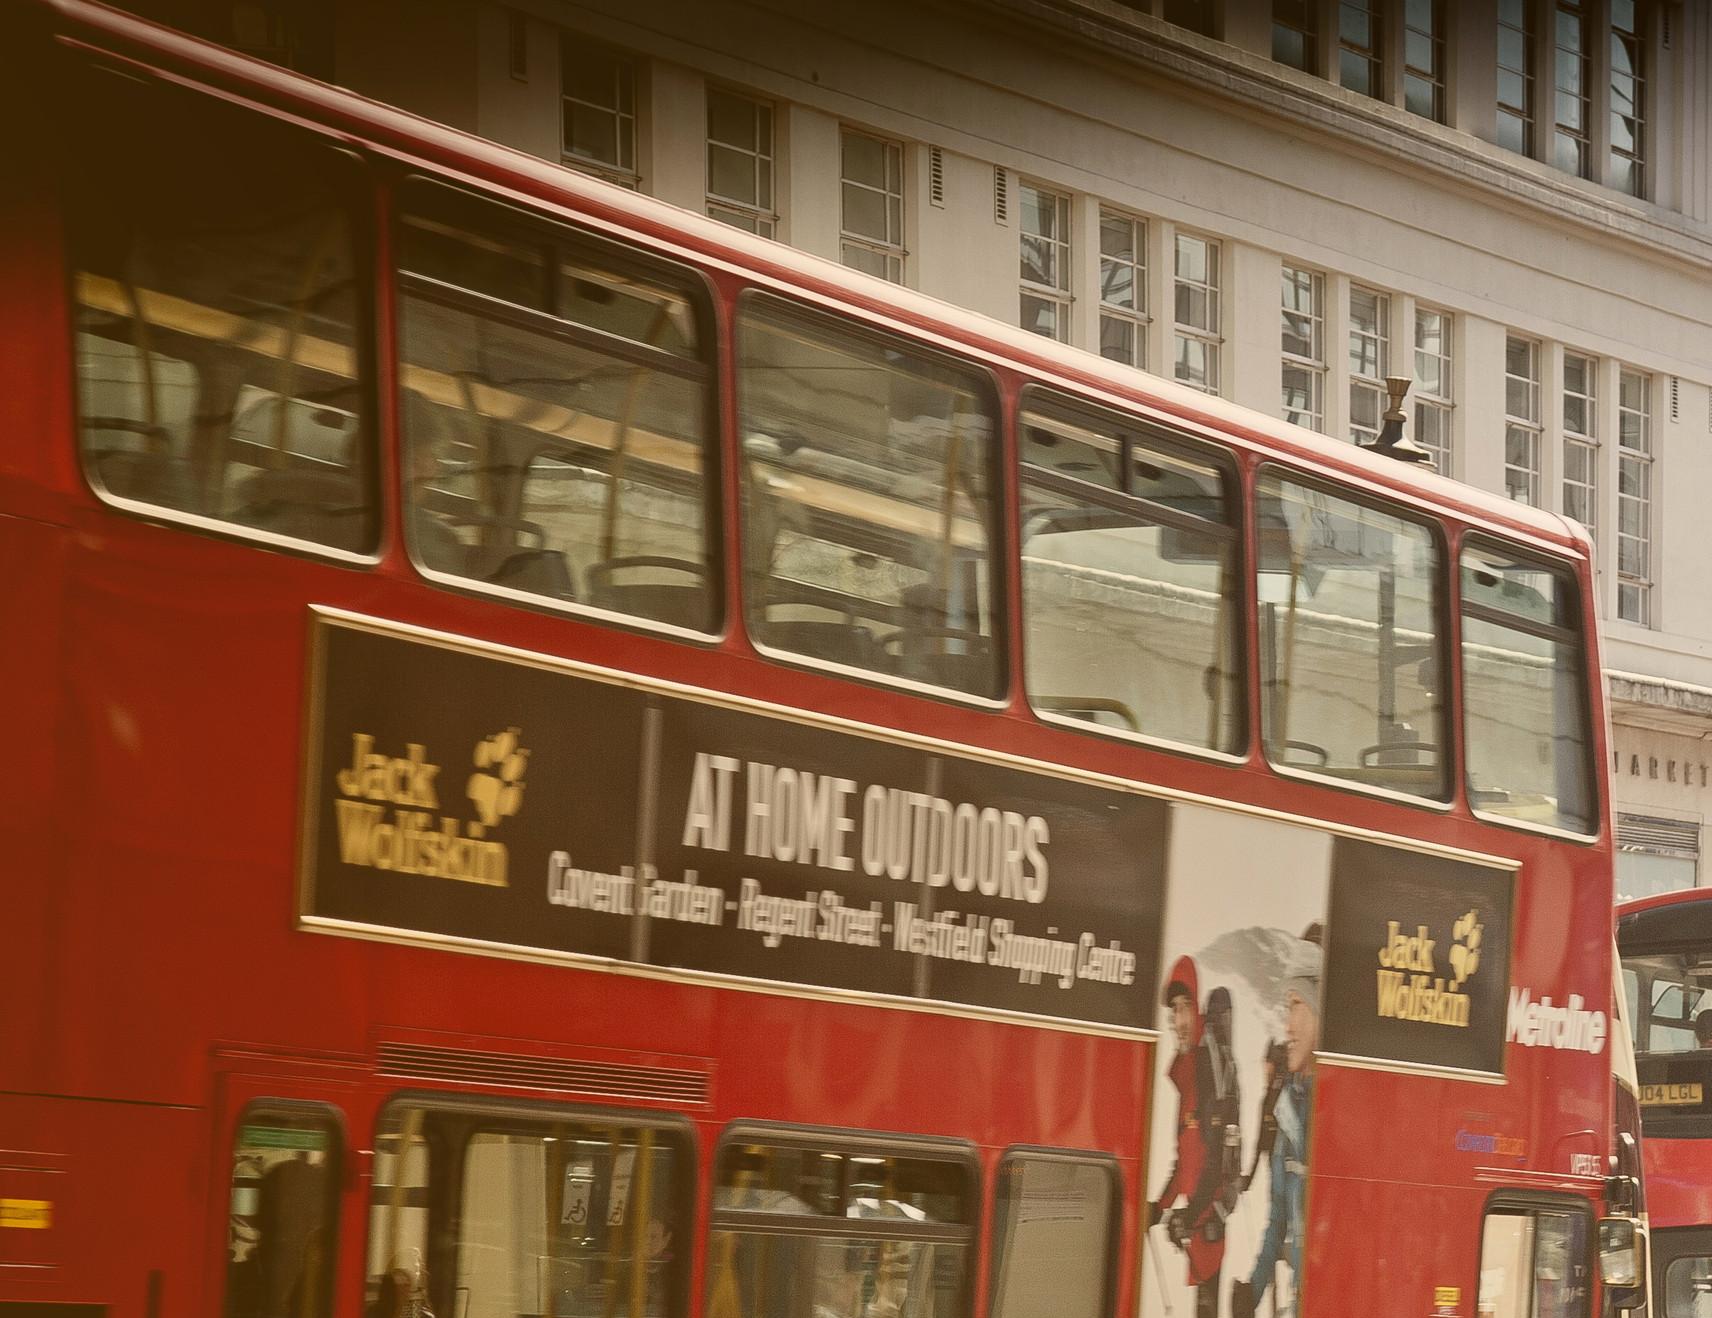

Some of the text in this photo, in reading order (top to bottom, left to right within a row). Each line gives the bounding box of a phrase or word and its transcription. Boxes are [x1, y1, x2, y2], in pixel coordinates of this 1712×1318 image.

[336, 733, 441, 809] Jack
[335, 799, 509, 887] Wolfskin
[682, 752, 1050, 903] AT HOME OUTDOORS
[737, 878, 818, 948] Regent
[817, 890, 882, 947] Street
[894, 902, 990, 964] Westfield
[988, 918, 1078, 989] Shopping
[1076, 932, 1136, 985] Centre
[1378, 921, 1436, 972] Jack
[1376, 969, 1472, 1027] Wolfskin
[1505, 986, 1607, 1054] Metroline
[1669, 1084, 1698, 1099] LGL
